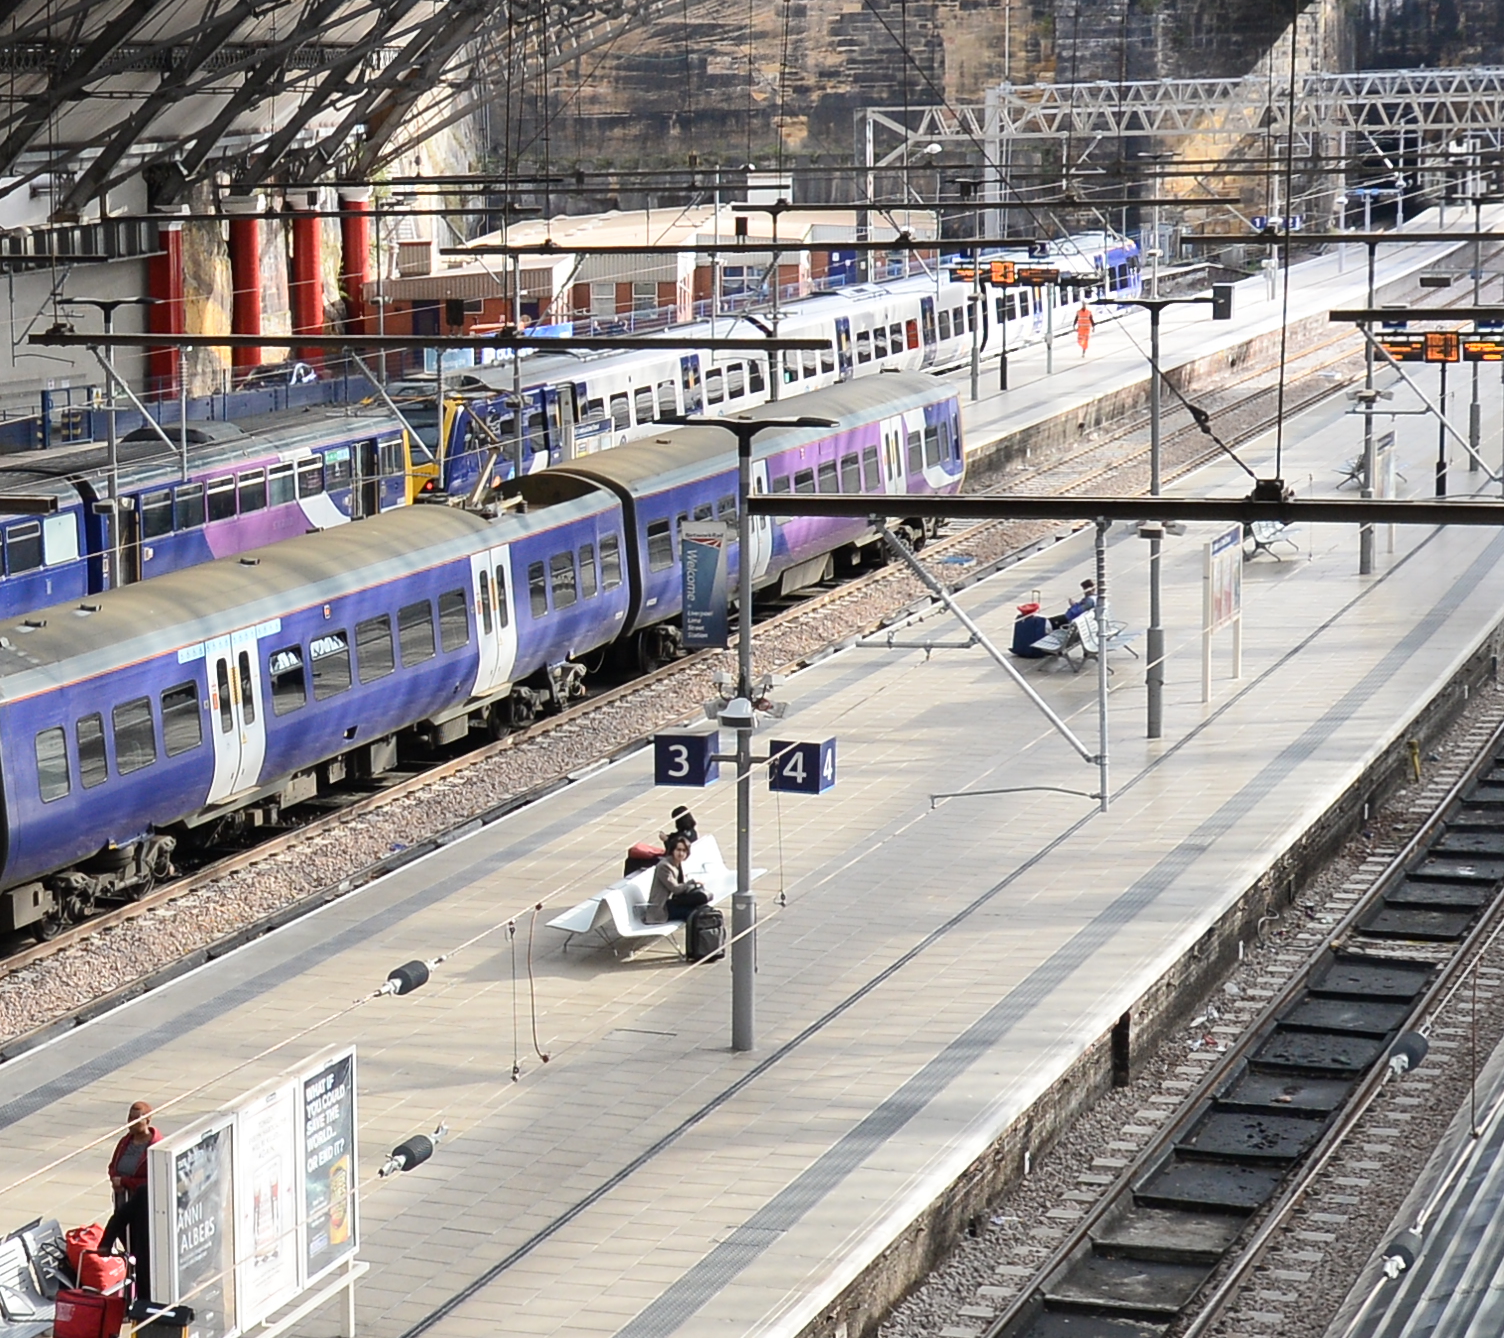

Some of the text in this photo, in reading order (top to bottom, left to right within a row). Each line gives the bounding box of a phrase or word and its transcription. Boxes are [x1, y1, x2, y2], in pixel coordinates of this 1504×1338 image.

[1033, 244, 1041, 256] 2
[687, 549, 698, 601] Welcome
[667, 744, 690, 778] 3
[782, 751, 807, 784] 4
[823, 747, 833, 780] 4
[305, 1073, 335, 1102] WHAT IF
[306, 1084, 346, 1119] YOU COULD
[306, 1103, 340, 1136] SAVE THE
[306, 1137, 345, 1173] OR END IT?
[177, 1201, 203, 1233] ANNI
[181, 1216, 215, 1254] ALBERS
